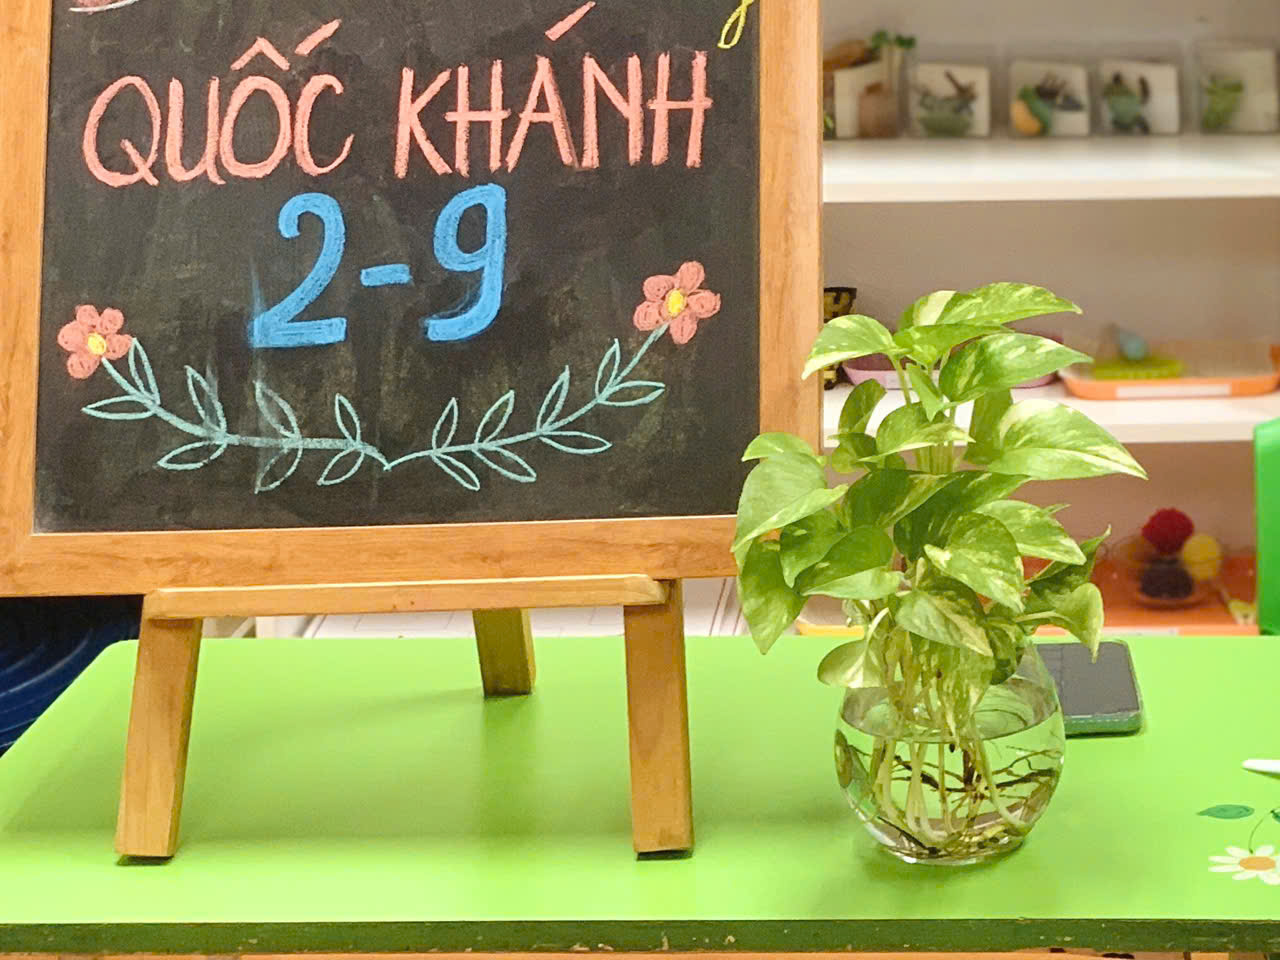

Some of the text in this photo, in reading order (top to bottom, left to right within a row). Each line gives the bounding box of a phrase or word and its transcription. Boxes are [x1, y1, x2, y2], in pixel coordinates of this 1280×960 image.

[82, 1, 713, 187] QUỐC KHÁNH
[251, 182, 507, 348] 2-9
